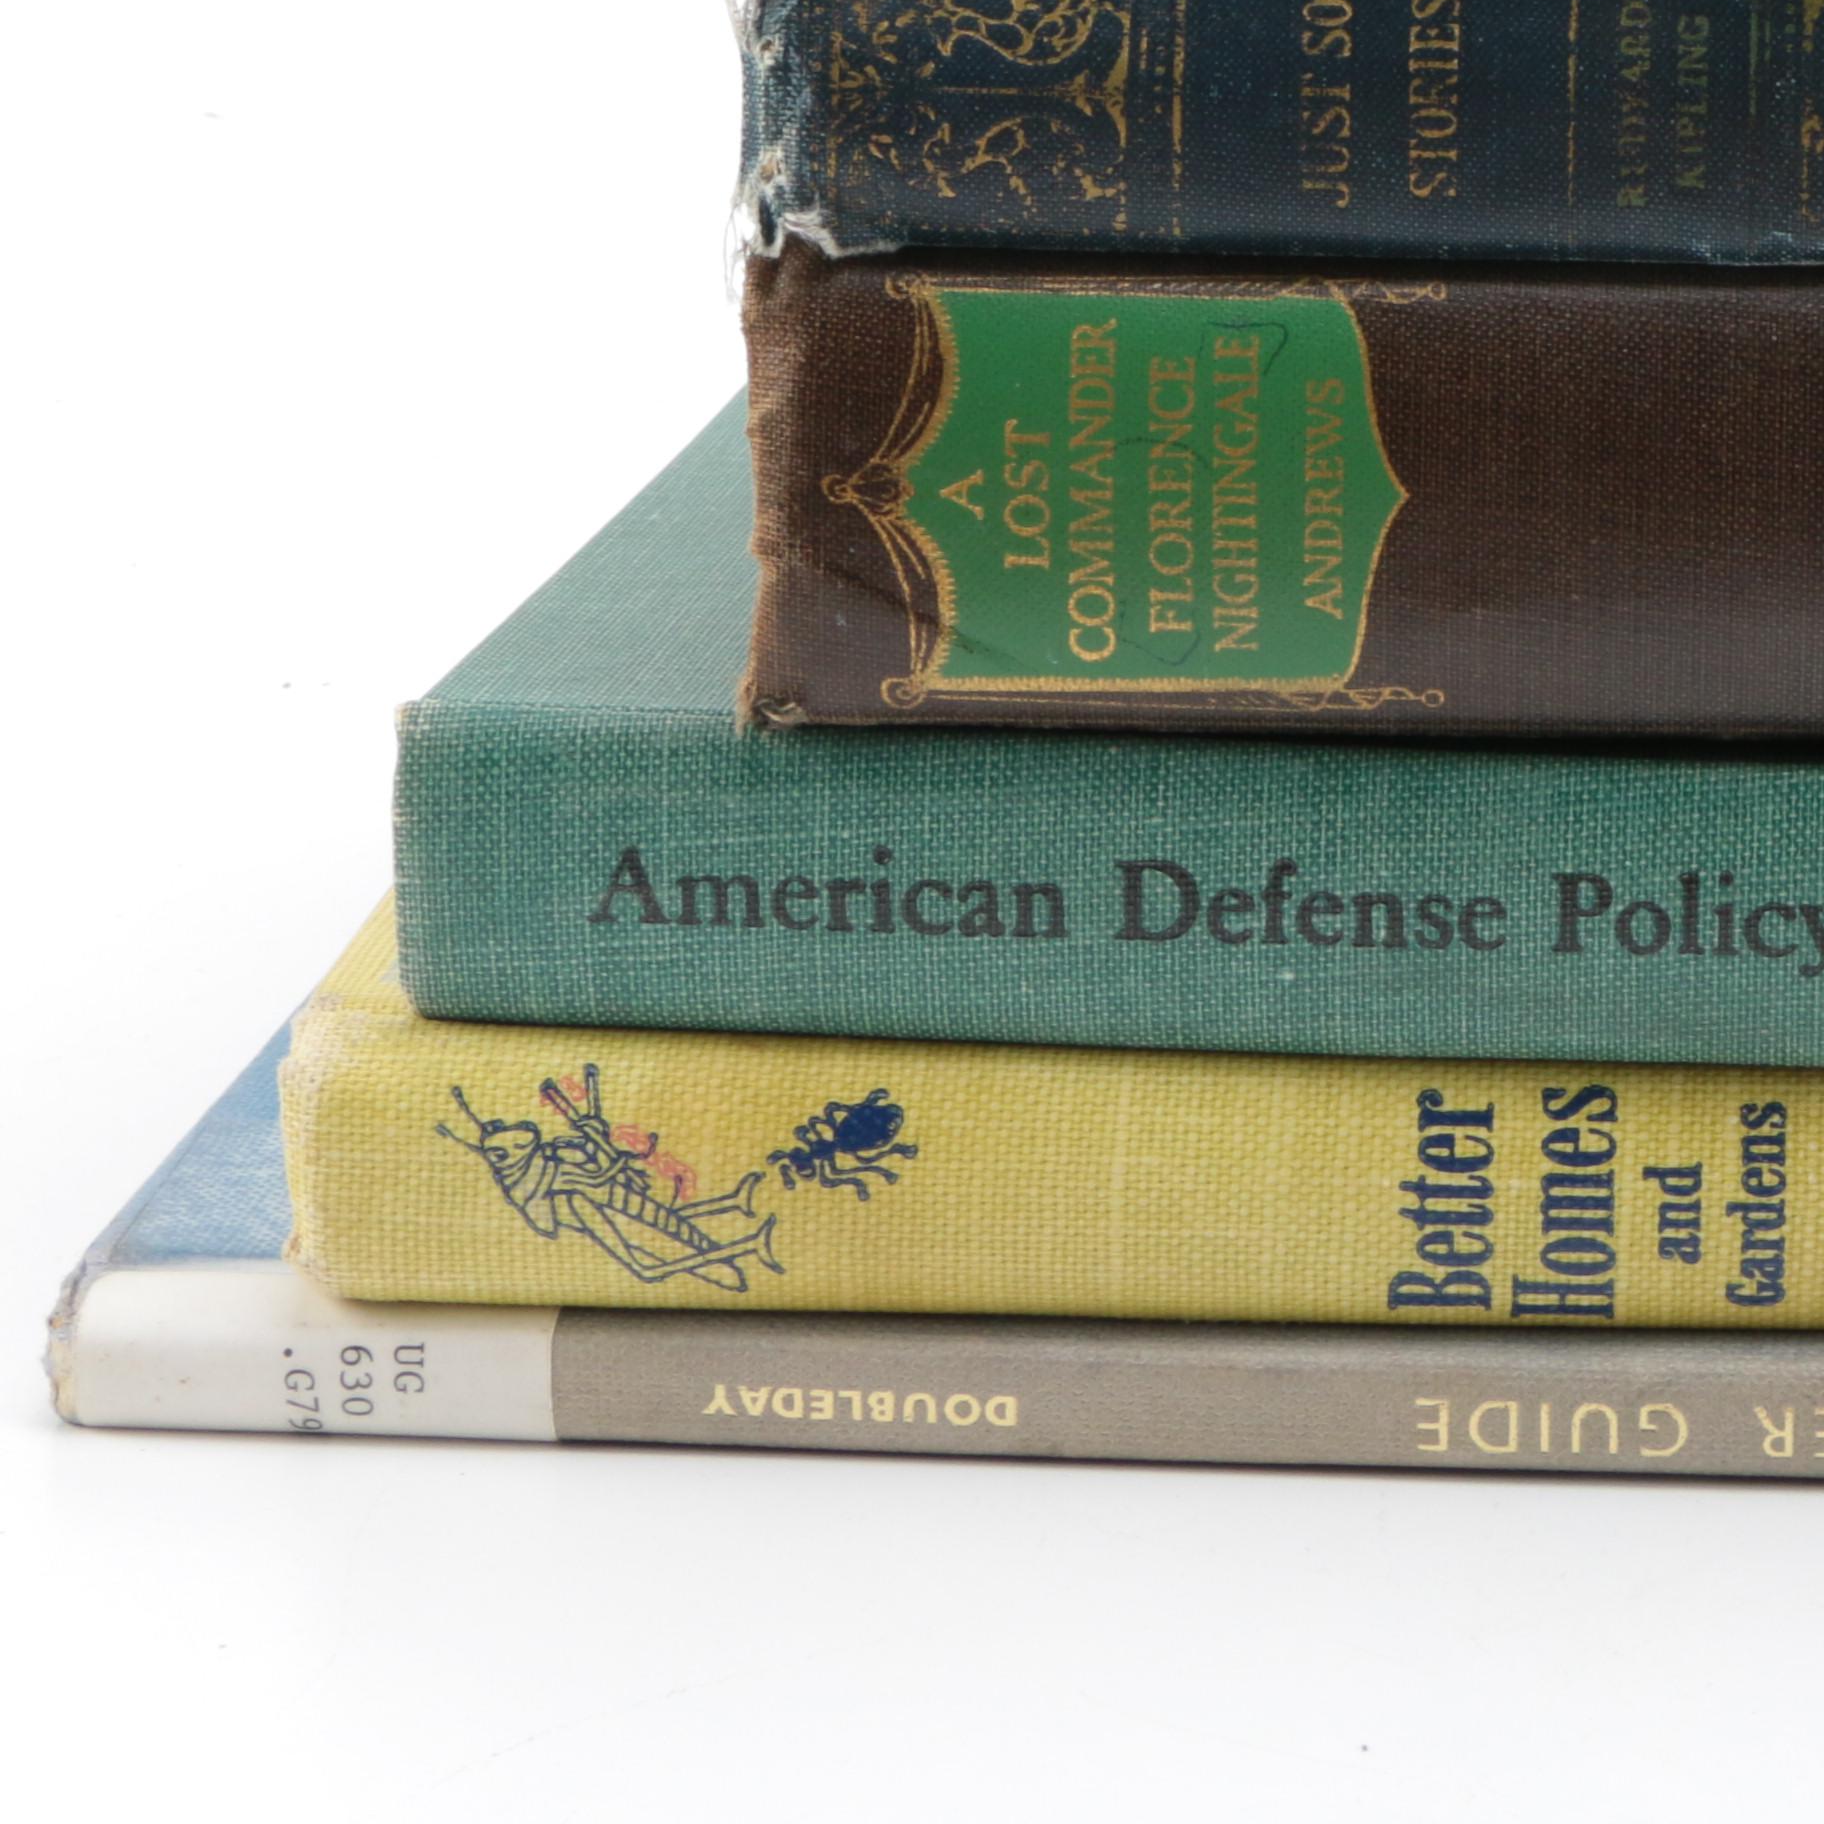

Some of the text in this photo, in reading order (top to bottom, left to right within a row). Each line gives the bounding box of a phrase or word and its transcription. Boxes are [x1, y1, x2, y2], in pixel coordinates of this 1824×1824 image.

[1301, 71, 1352, 210] JUST
[1676, 13, 1710, 190] KIPLING
[938, 468, 985, 521] A
[1003, 417, 1052, 571] LOST
[1068, 317, 1119, 663] COMMANDER
[1148, 354, 1197, 634] FLORENCE
[1211, 334, 1261, 653] NIGHTINGALE
[1303, 378, 1345, 621] ANDREWS
[587, 844, 1069, 940] American
[1112, 857, 1509, 952] Defense
[1387, 1088, 1495, 1311] Better
[1510, 1084, 1619, 1320] Homes
[1643, 1160, 1703, 1265] and
[1725, 1100, 1788, 1307] Gardens
[340, 1344, 375, 1417] 630
[393, 1341, 426, 1395] UG
[701, 1382, 1018, 1428] DOUBLEDAY
[1413, 1396, 1691, 1459] GUIDE
